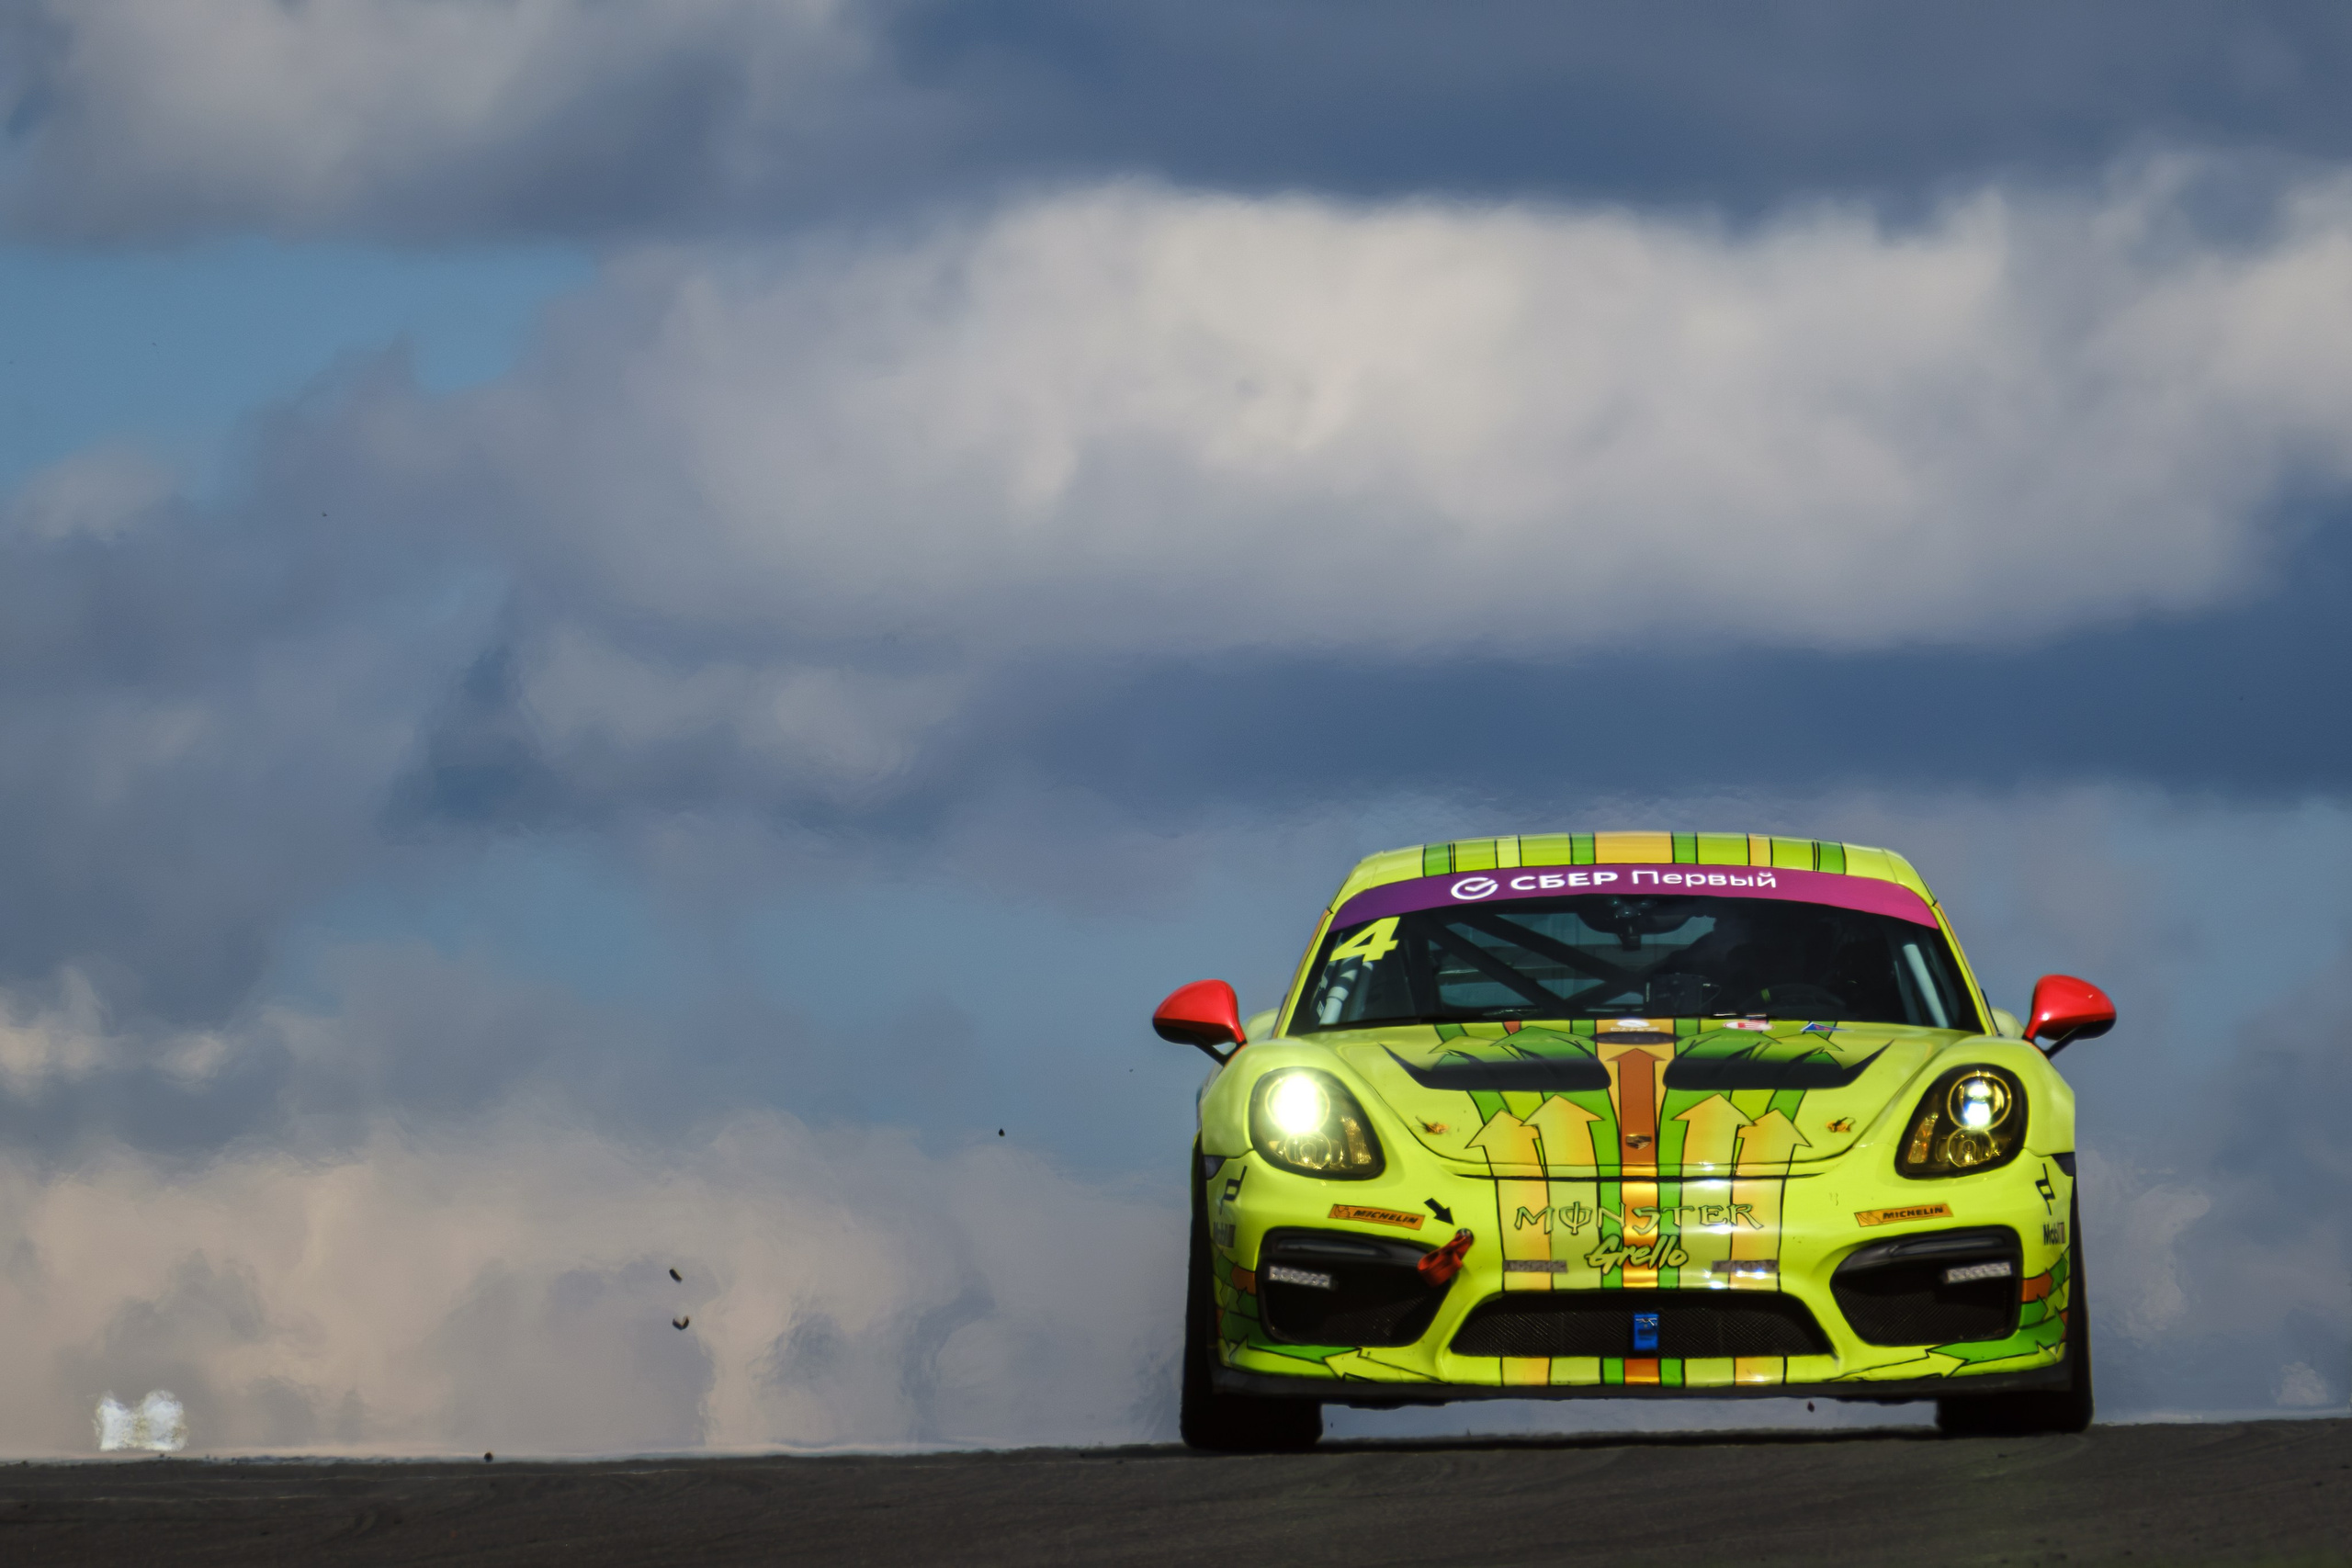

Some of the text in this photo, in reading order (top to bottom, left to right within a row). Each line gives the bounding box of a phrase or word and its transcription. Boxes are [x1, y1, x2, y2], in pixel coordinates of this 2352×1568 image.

[1510, 870, 1777, 891] СБЕР Первый
[1329, 917, 1400, 962] 4
[1352, 1209, 1419, 1224] MICHELIN
[1882, 1206, 1944, 1220] MICHELIN
[1583, 1233, 1689, 1275] Grello
